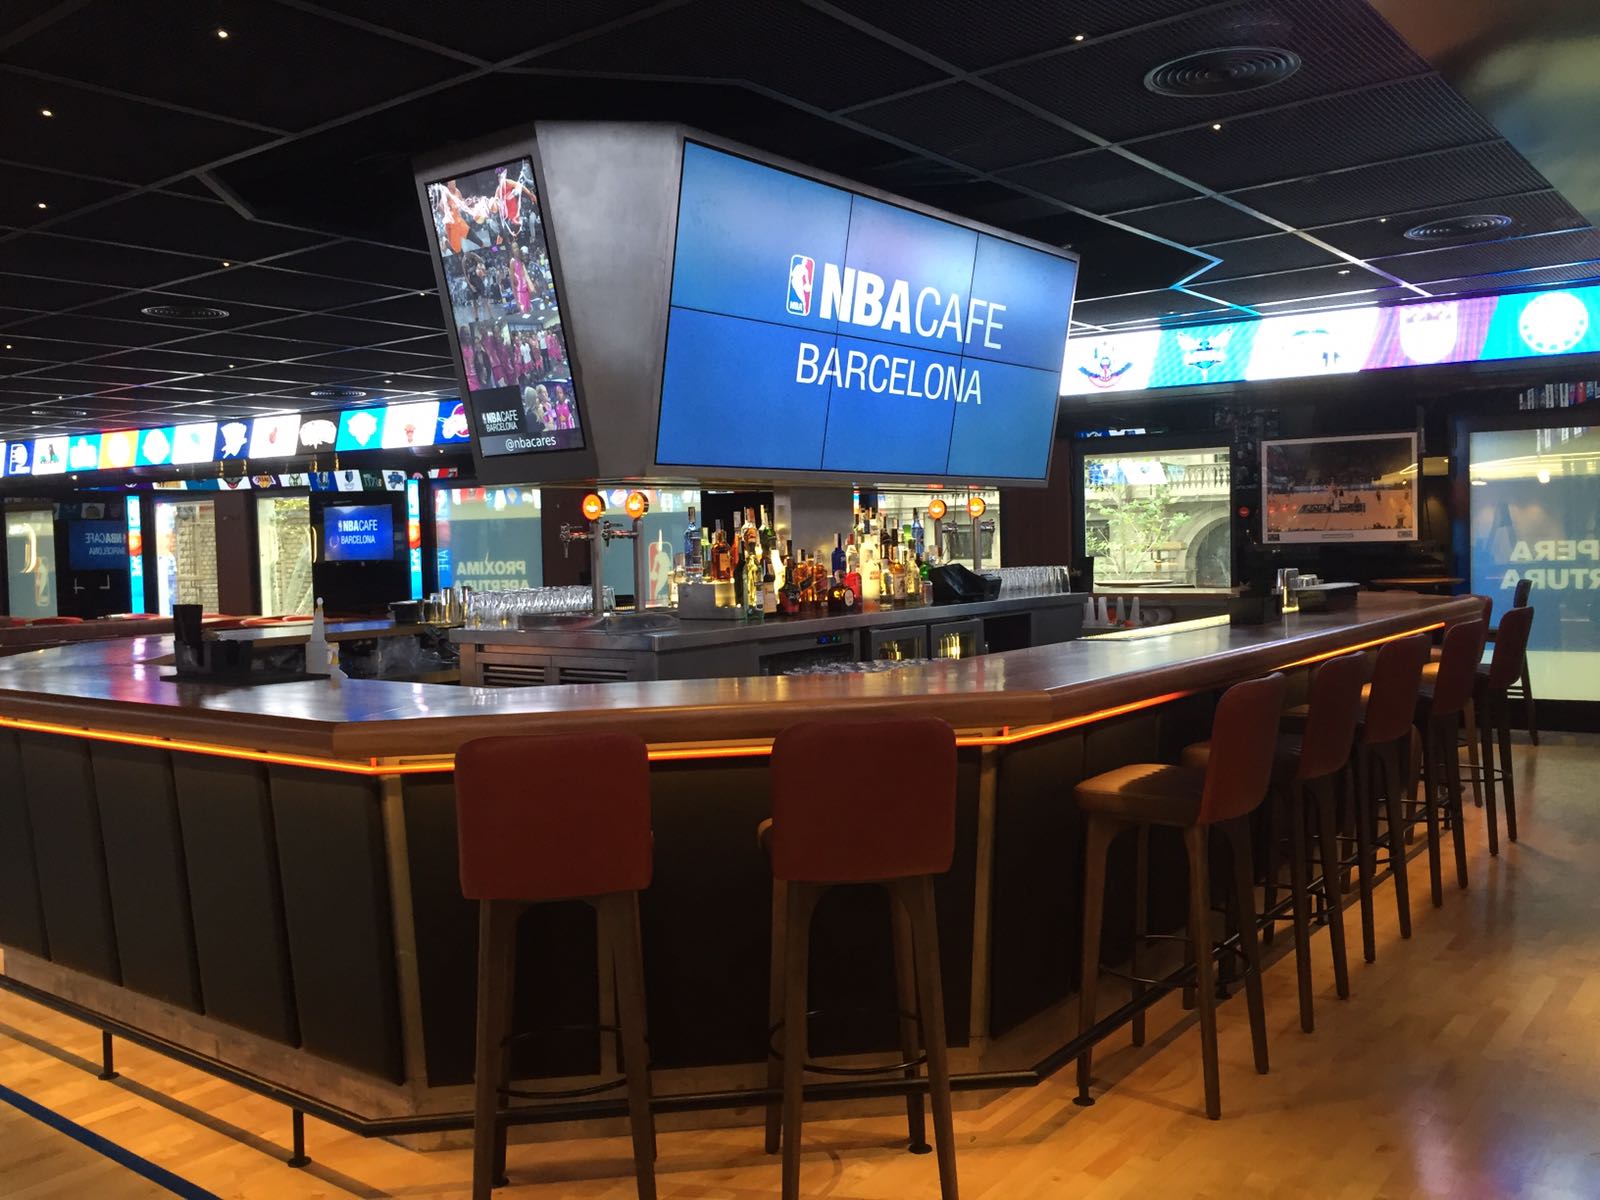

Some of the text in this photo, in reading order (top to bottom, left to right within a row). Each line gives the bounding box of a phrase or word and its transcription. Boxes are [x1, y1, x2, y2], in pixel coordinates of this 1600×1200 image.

[796, 342, 982, 406] BARCELONA
[486, 422, 518, 433] BARCELONA
[505, 436, 557, 451] @nbacares
[341, 534, 376, 545] BARCELONA
